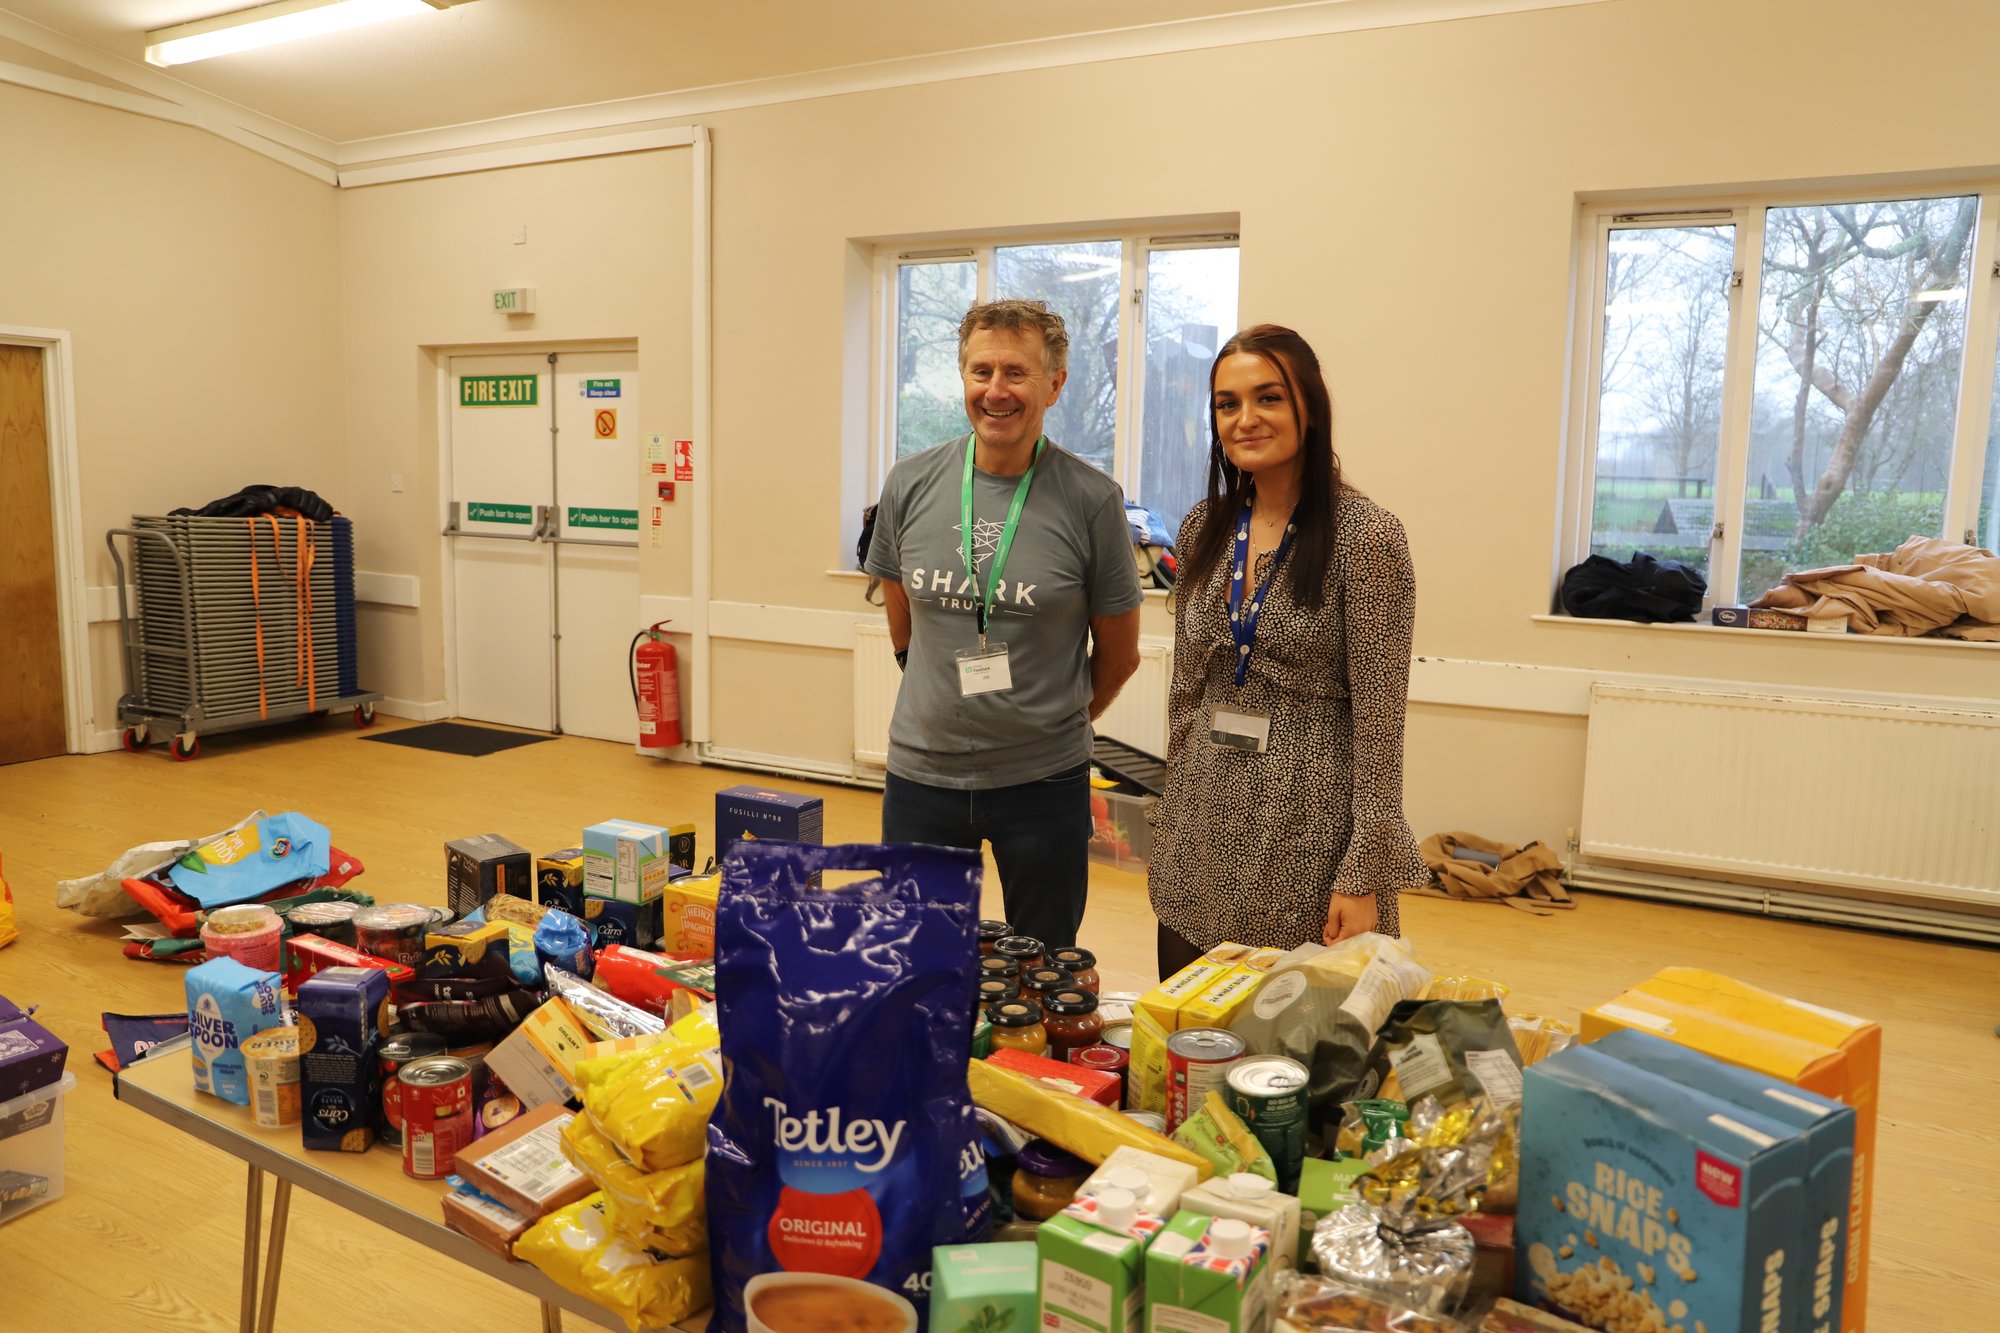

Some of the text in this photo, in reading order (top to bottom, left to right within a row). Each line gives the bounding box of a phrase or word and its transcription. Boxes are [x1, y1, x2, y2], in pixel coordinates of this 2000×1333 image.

[494, 291, 516, 309] EXIT
[464, 380, 533, 402] FIRE EXIT
[590, 389, 602, 397] Keep
[479, 509, 532, 520] Push bar to open
[580, 514, 638, 525] Push bar to open
[910, 567, 1038, 606] SHARK
[729, 807, 759, 818] FUSILLI
[686, 906, 712, 920] HEINZ
[683, 920, 714, 935] SPAGHETT
[1175, 976, 1192, 990] WHEAT
[1218, 985, 1235, 999] WHEAT
[191, 1010, 236, 1036] SILVER
[189, 1023, 239, 1050] SPOON
[558, 1026, 581, 1050] CREAMY
[763, 1096, 907, 1173] Tetley
[793, 1159, 823, 1168] SINCE
[1594, 1160, 1664, 1221] RICE
[779, 1217, 867, 1238] ORIGINAL
[1566, 1181, 1693, 1275] SNAPS
[782, 1234, 816, 1245] Delicious
[824, 1239, 863, 1250] Refreshing
[1812, 1217, 1839, 1319] SNAPS
[1759, 1248, 1785, 1333] NAPS
